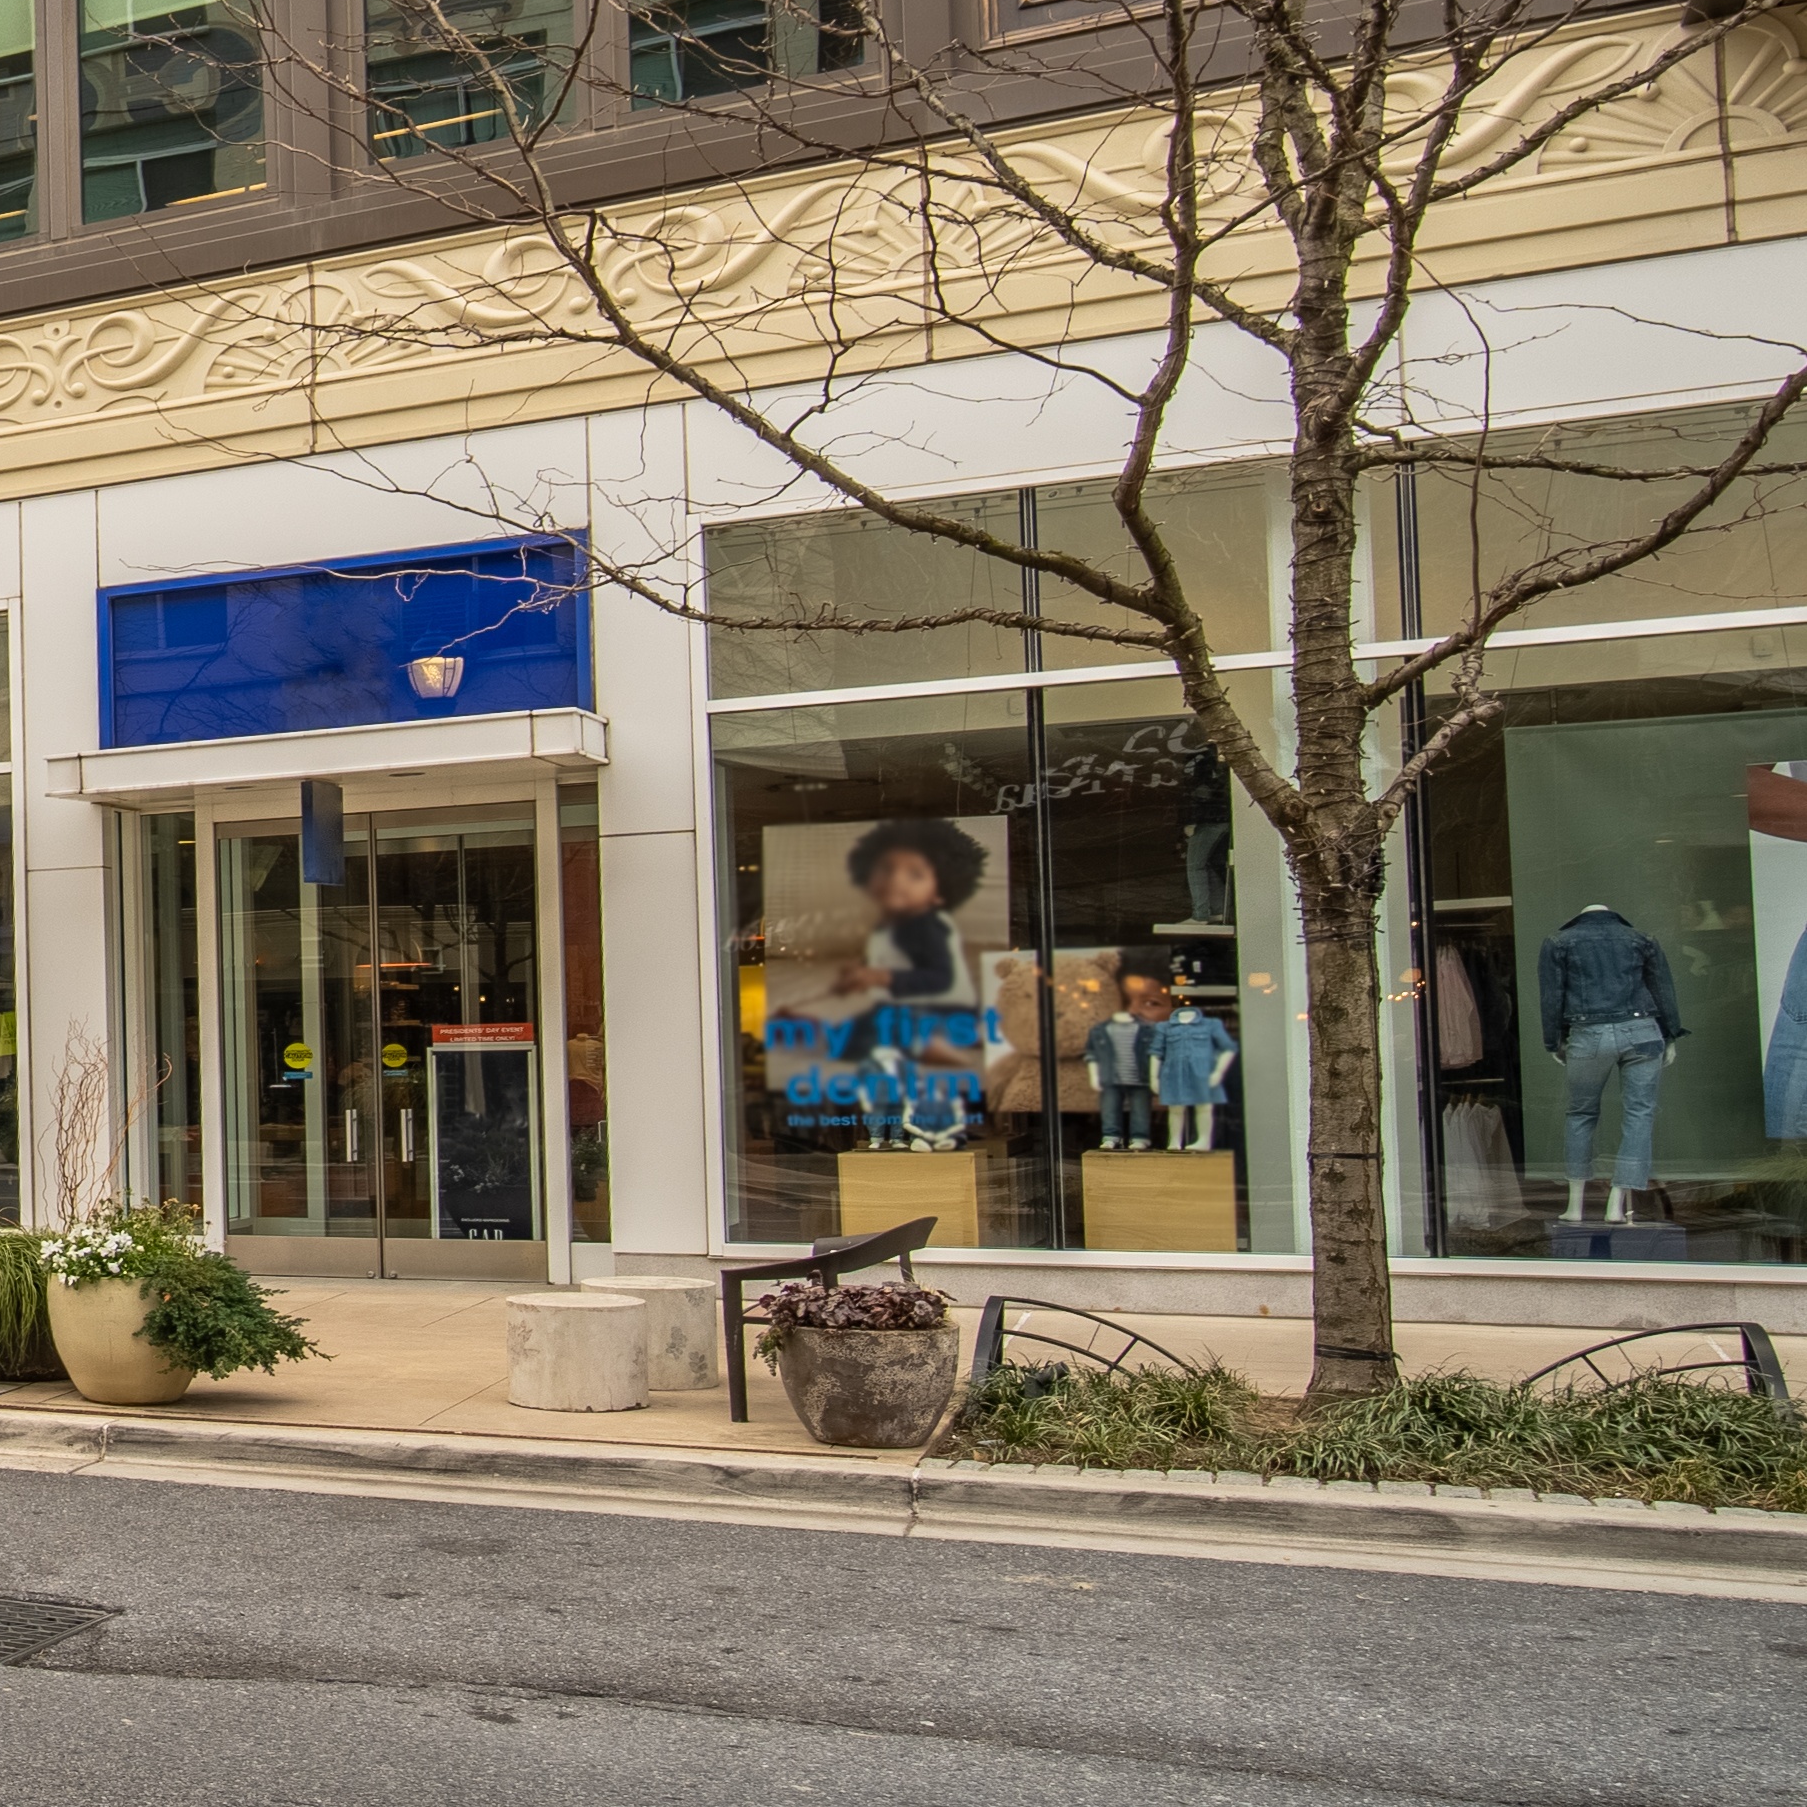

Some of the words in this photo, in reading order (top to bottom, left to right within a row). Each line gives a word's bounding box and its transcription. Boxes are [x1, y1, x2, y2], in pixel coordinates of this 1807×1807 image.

[485, 1026, 499, 1034] DAY
[500, 1026, 525, 1034] EVENT
[765, 1017, 853, 1060] my
[875, 1005, 1004, 1048] first
[785, 1061, 983, 1106] denim
[787, 1114, 817, 1127] the
[819, 1113, 858, 1126] best
[862, 1113, 901, 1126] from
